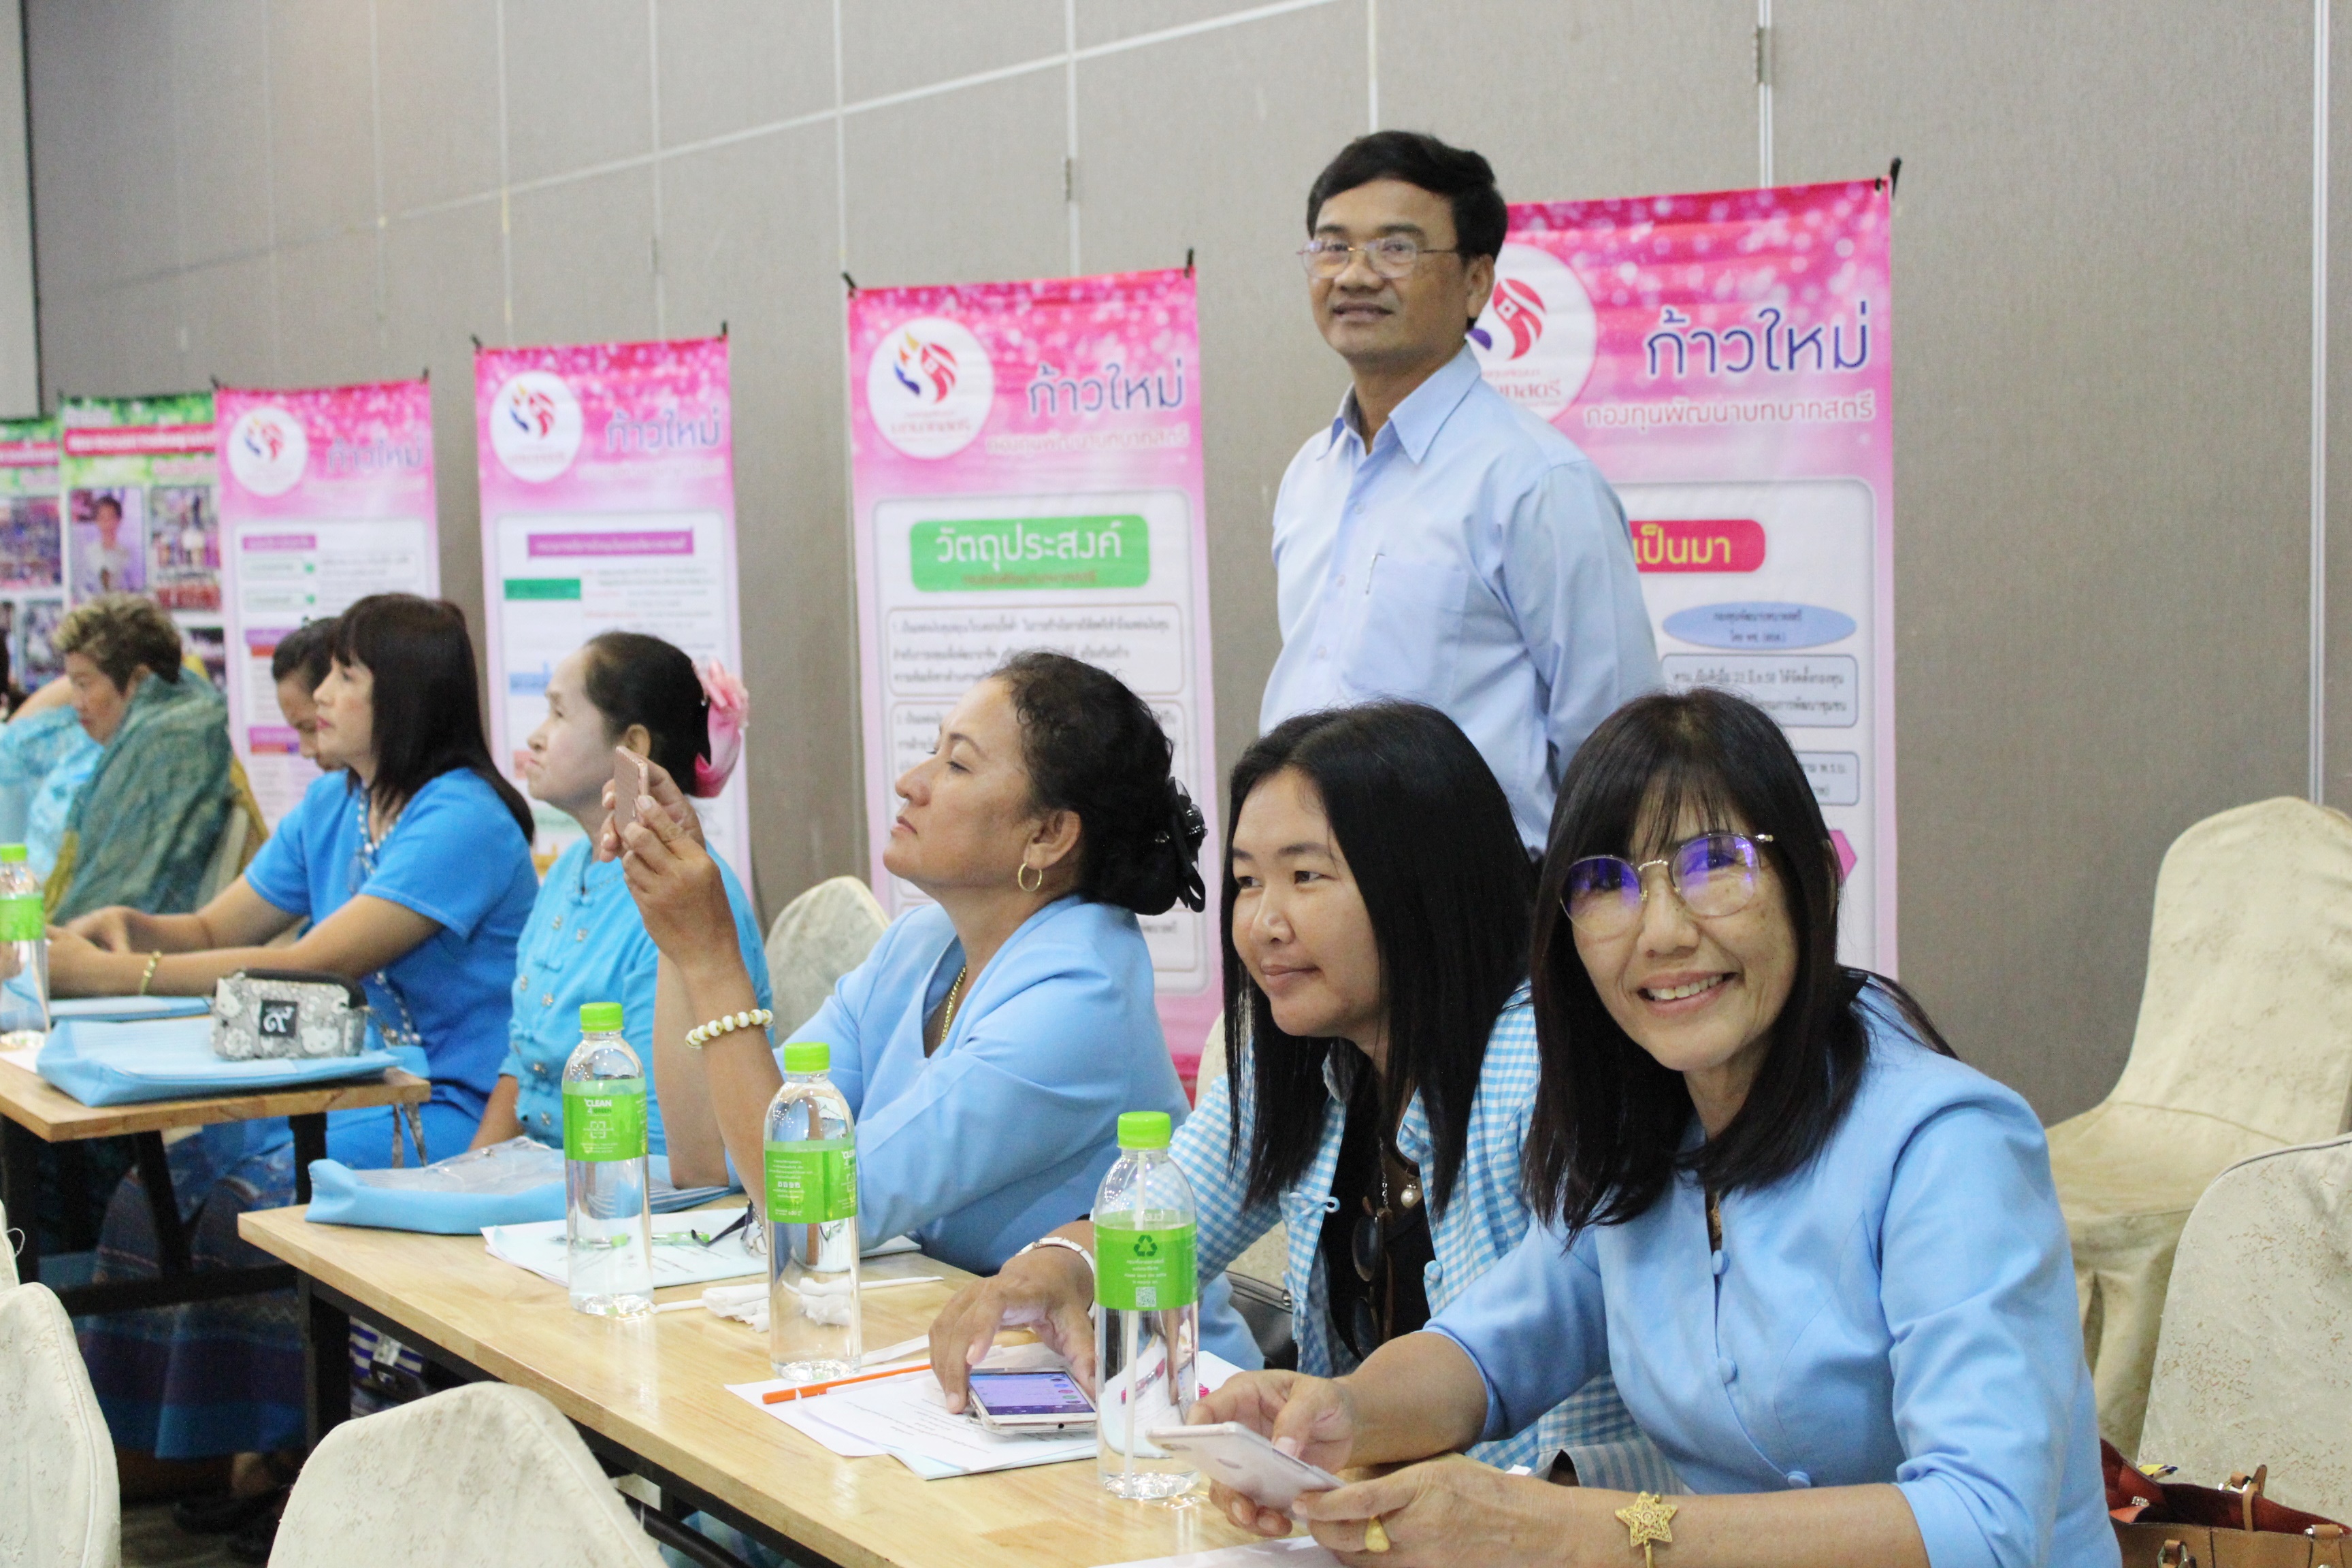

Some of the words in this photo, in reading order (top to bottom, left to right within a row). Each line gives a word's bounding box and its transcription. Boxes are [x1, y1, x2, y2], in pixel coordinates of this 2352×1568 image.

[1648, 300, 1867, 375] ก้าวใหม่
[1029, 358, 1183, 413] ก้าวใหม่
[1585, 389, 1874, 432] กองทุนพัฒนาบทบาทสตรี
[936, 521, 1123, 572] วัตถุประสงค์
[585, 1098, 612, 1107] CLEAN
